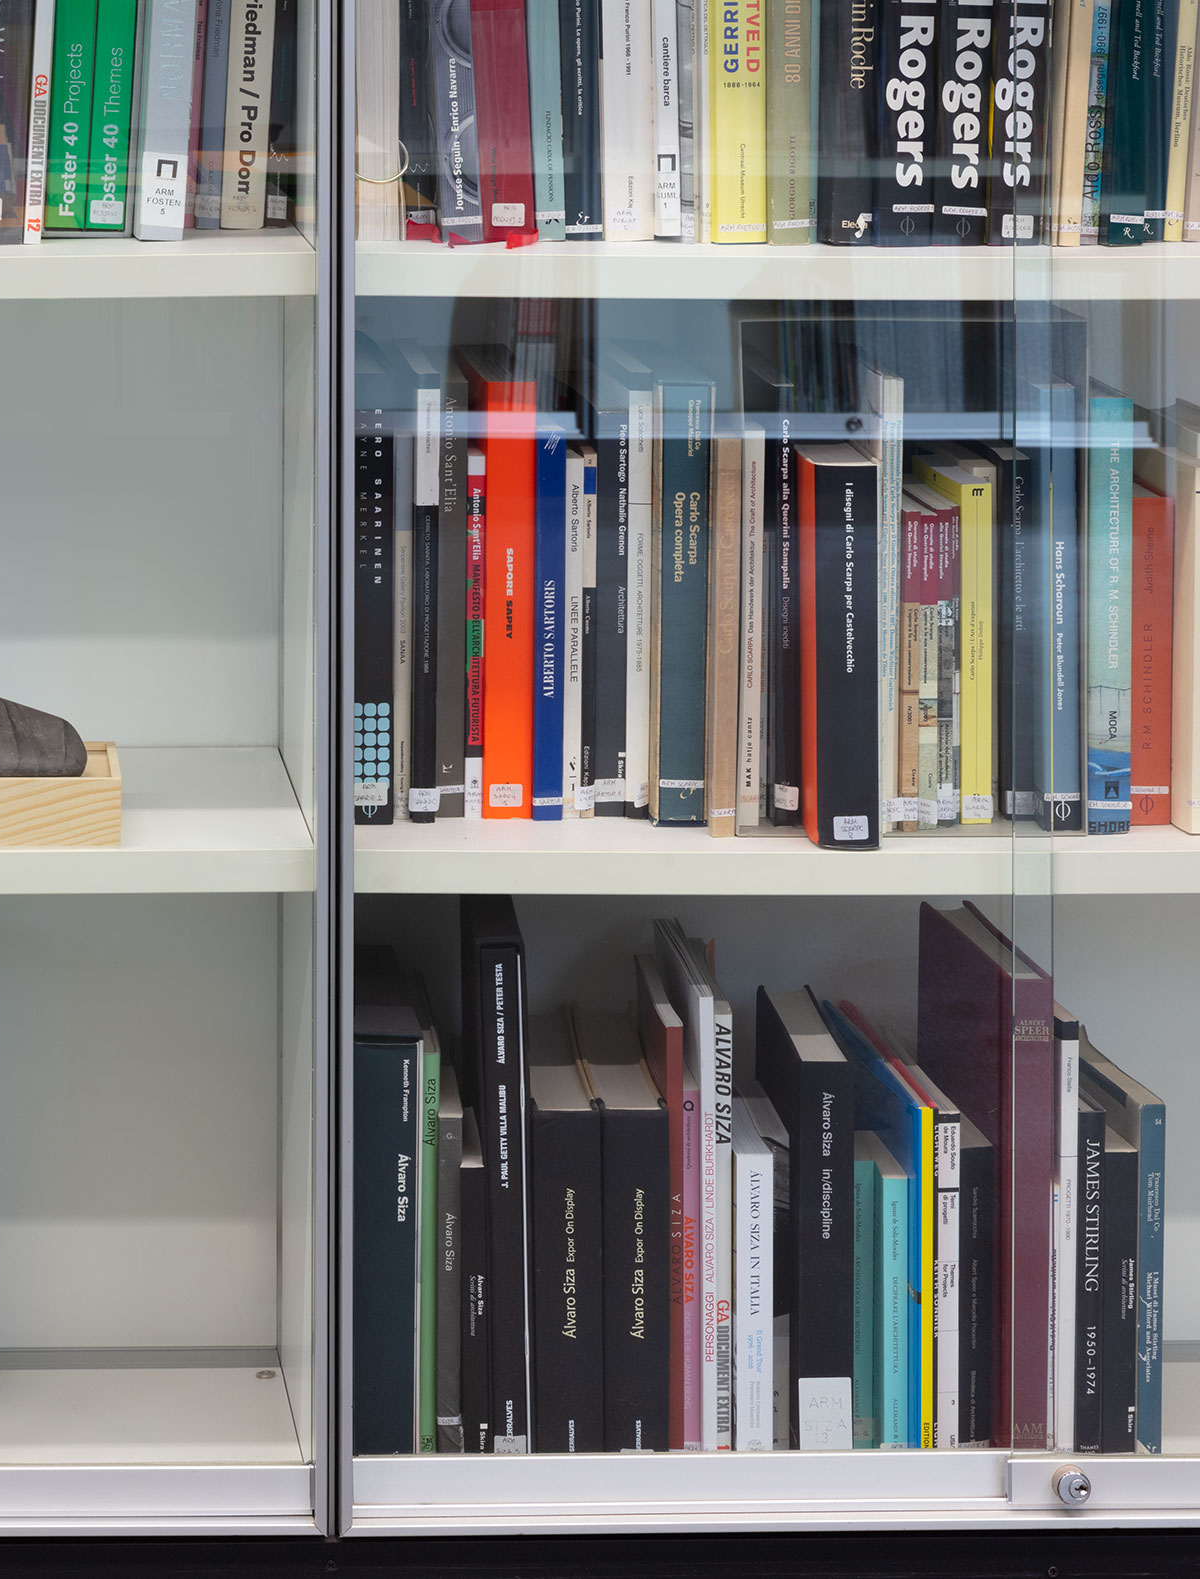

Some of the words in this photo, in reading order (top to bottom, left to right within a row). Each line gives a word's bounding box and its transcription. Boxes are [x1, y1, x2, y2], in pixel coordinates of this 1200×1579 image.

[662, 36, 671, 76] cantiere
[849, 25, 875, 88] Roche
[36, 75, 49, 98] GA
[63, 43, 86, 113] Projects
[662, 78, 671, 106] barca
[885, 15, 934, 187] Rogers
[942, 17, 992, 189] Rogers
[995, 16, 1045, 187] Rogers
[31, 100, 47, 166] DOCUMENT
[62, 121, 78, 146] 40
[29, 170, 43, 207] EXTRA
[58, 151, 77, 216] Foster
[155, 188, 174, 196] ARM
[1083, 162, 1100, 200] Aldo
[146, 197, 181, 206] FOSTEN
[27, 218, 40, 232] 12
[1109, 440, 1121, 463] THE
[672, 490, 685, 526] Opera
[689, 491, 702, 522] Carlo
[843, 488, 854, 521] disegni
[1109, 468, 1120, 554] ARCHITECTURE
[374, 478, 382, 583] SAARINEN
[686, 524, 700, 564] Scarpa
[845, 523, 854, 532] di
[845, 535, 854, 559] Carlo
[504, 546, 515, 596] SAPORE
[672, 528, 685, 582] completa
[1055, 541, 1064, 570] Hans
[1109, 558, 1119, 572] OF
[844, 561, 854, 592] Scarpa
[1109, 575, 1118, 586] R.
[1109, 589, 1118, 602] M.
[543, 580, 555, 639] SARTORIS
[844, 594, 852, 610] per
[1055, 572, 1065, 624] Scharoun
[505, 600, 513, 639] SAPEY
[1108, 605, 1118, 668] SCHINDLER
[846, 612, 855, 673] Castelvecchio
[543, 643, 555, 698] ALBERTO
[1108, 709, 1118, 739] MOCA
[822, 1091, 835, 1130] Álvaro
[822, 1131, 833, 1156] Siza
[397, 1153, 411, 1192] Álvaro
[1085, 1138, 1100, 1200] JAMES
[397, 1196, 409, 1222] Siza
[750, 1170, 763, 1219] ÁLVARO
[819, 1168, 833, 1239] in/discipline
[750, 1223, 760, 1250] SIZA
[1084, 1204, 1099, 1292] STIRLING
[750, 1256, 760, 1269] IN
[750, 1275, 760, 1315] ITALIA
